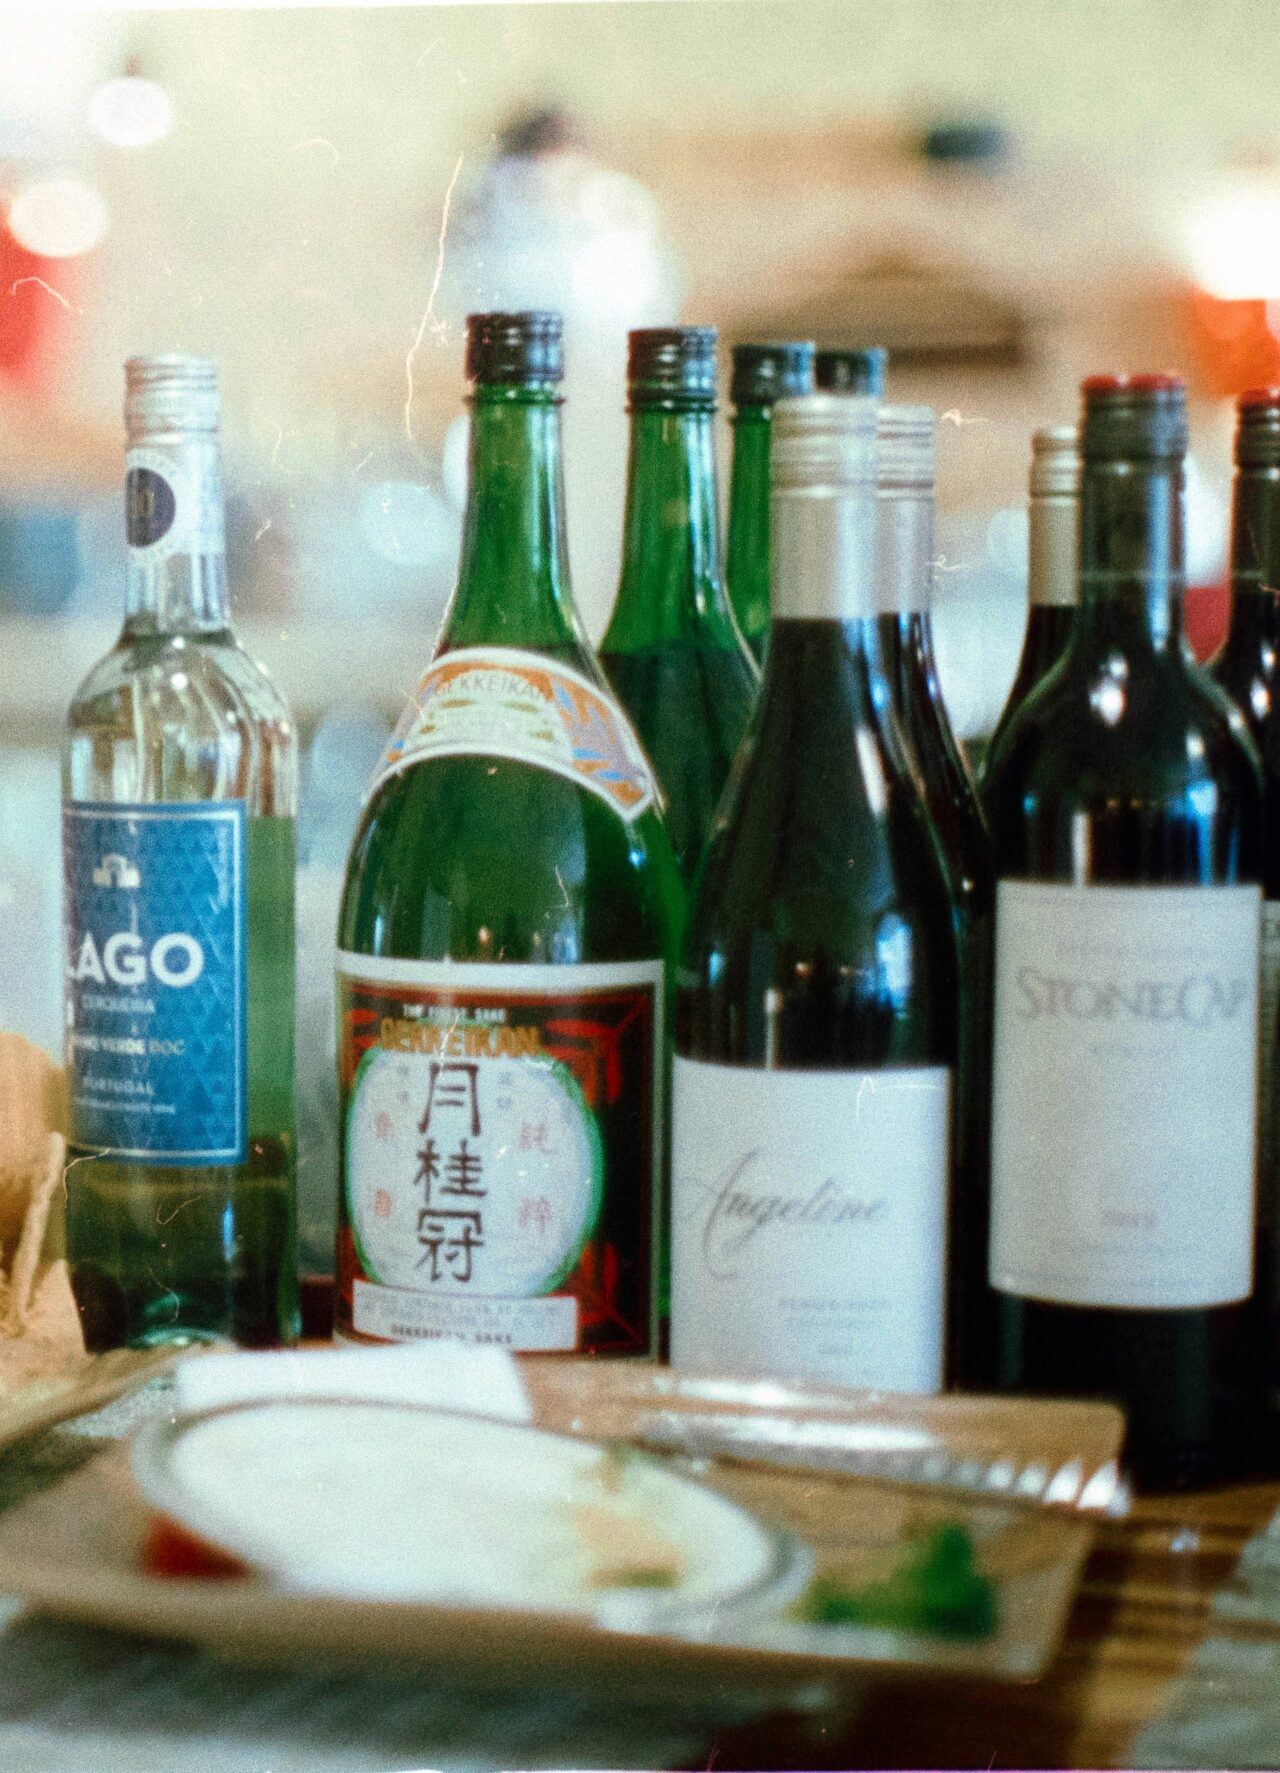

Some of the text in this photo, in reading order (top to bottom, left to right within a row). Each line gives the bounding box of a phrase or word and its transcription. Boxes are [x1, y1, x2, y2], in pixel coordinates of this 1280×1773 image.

[149, 1038, 186, 1056] DOC
[380, 1017, 541, 1058] GEKKEIKAN
[413, 1061, 486, 1283] 月桂冠
[677, 1146, 890, 1282] Angeline
